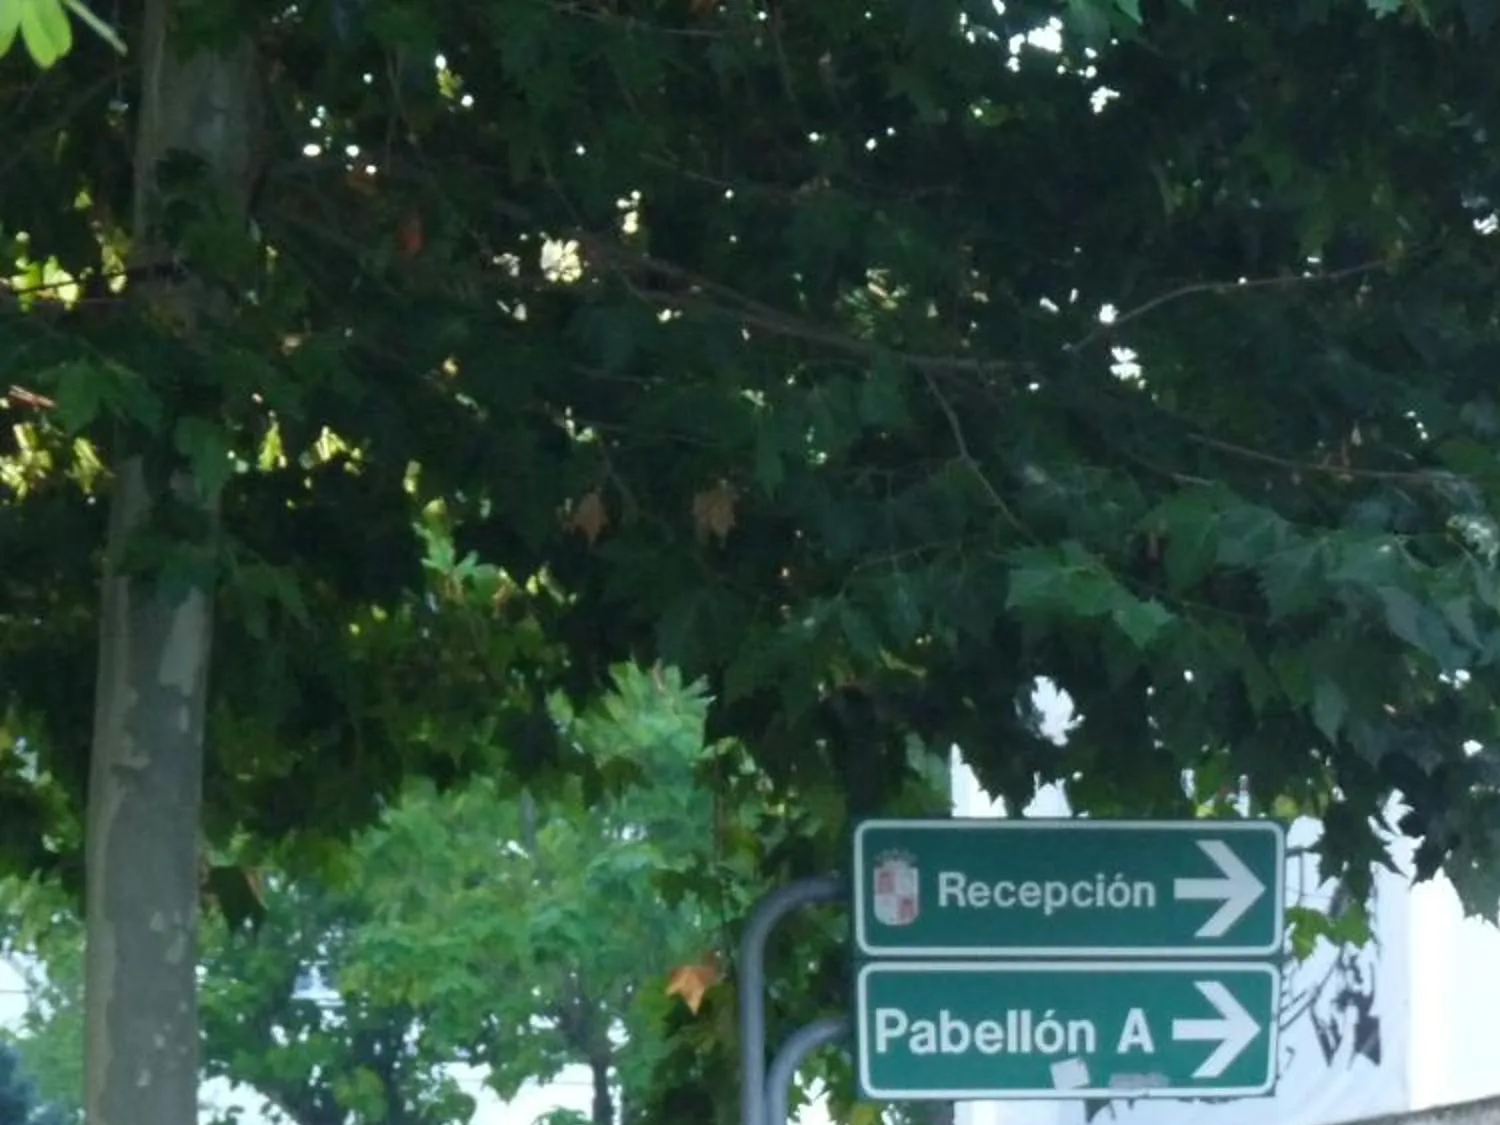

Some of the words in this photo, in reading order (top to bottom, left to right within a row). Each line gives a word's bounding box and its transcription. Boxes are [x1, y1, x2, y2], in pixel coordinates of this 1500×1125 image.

[937, 870, 1156, 916] Recepción
[875, 1007, 1096, 1054] Pabellón
[1116, 1007, 1155, 1054] A
